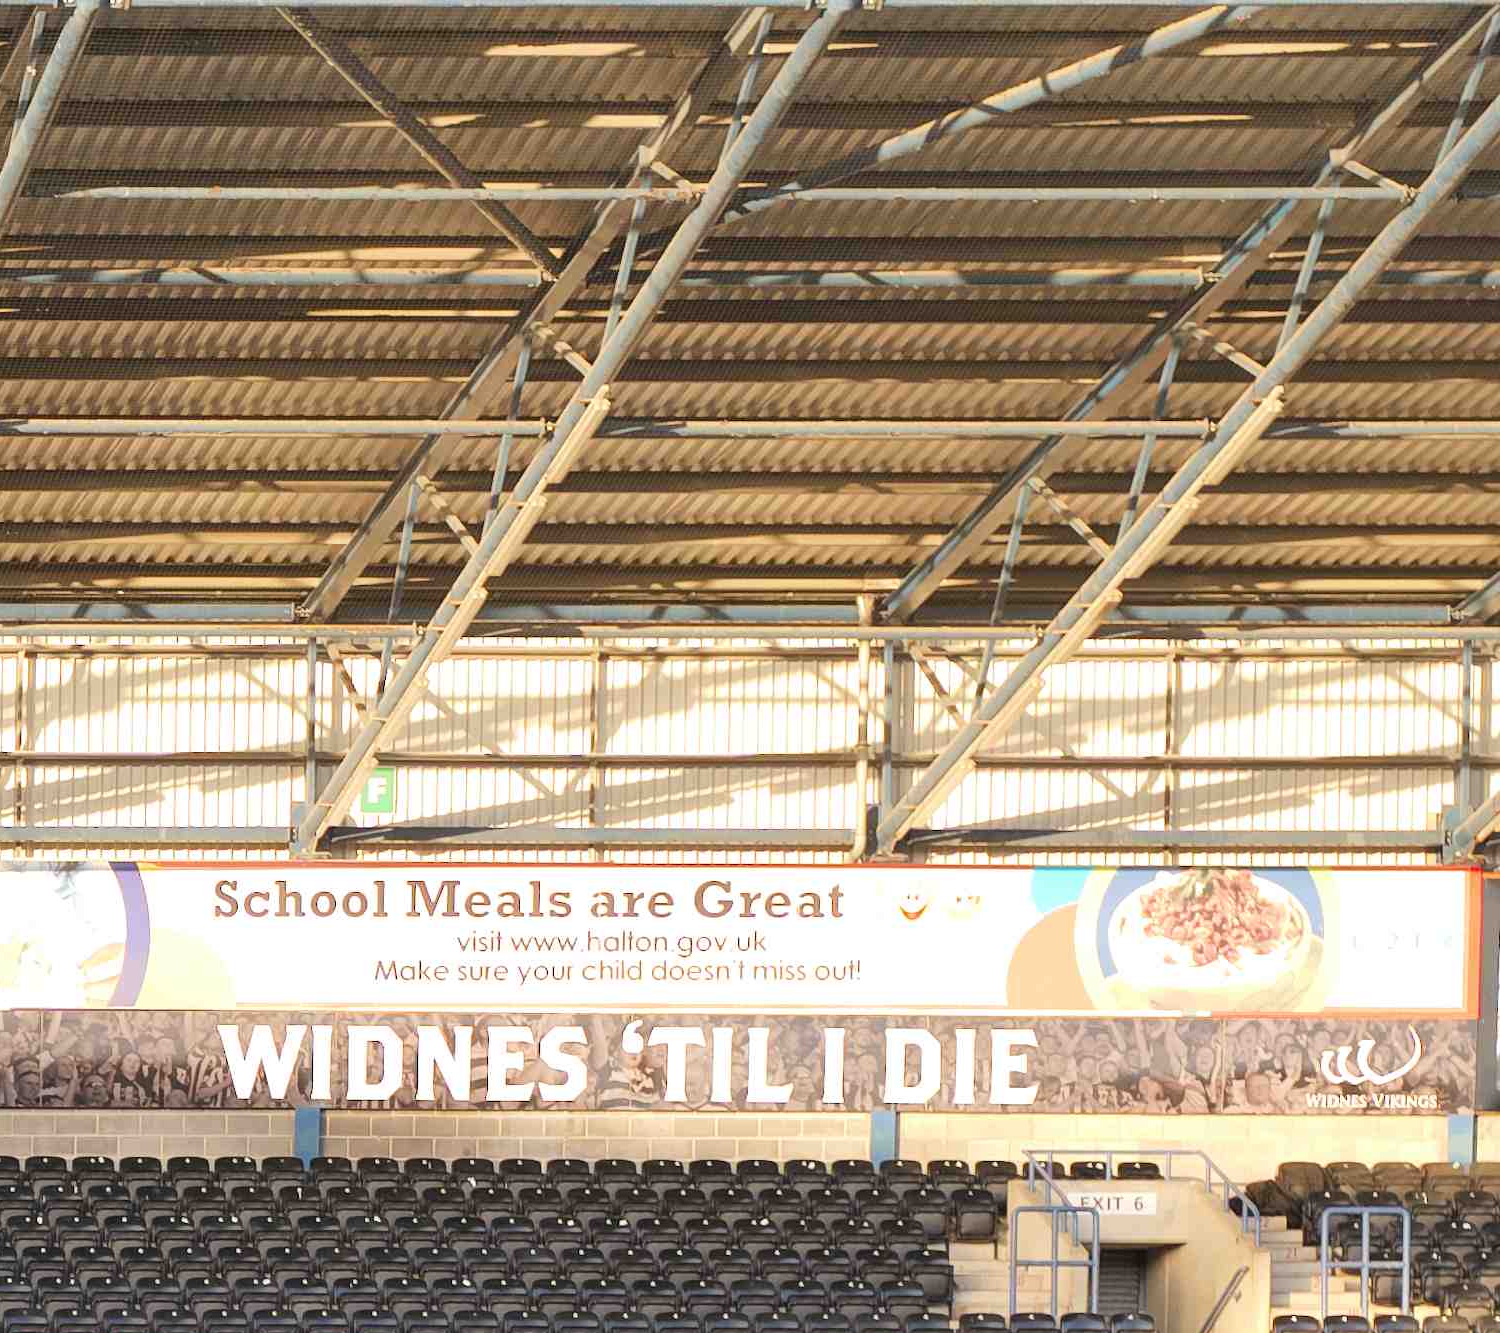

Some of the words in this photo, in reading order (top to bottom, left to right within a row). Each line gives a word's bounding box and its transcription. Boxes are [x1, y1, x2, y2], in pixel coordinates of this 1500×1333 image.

[366, 778, 387, 806] F
[213, 878, 388, 920] School
[406, 879, 572, 920] Meals
[590, 889, 674, 920] are
[692, 879, 846, 920] Great
[457, 932, 505, 953] visit
[511, 930, 767, 959] www.halton.gov.uk
[375, 958, 450, 982] Make
[457, 964, 510, 982] sure
[517, 964, 571, 988] your
[581, 957, 646, 982] child
[651, 957, 746, 982] doesn't
[753, 958, 806, 982] miss
[813, 957, 862, 982] out!
[218, 1024, 589, 1104] WIDNES
[823, 1028, 846, 1104] I
[884, 1028, 1041, 1104] DIE
[1305, 1091, 1370, 1109] WIDNES
[1080, 1196, 1124, 1211] EXIT
[1134, 1196, 1144, 1211] 6
